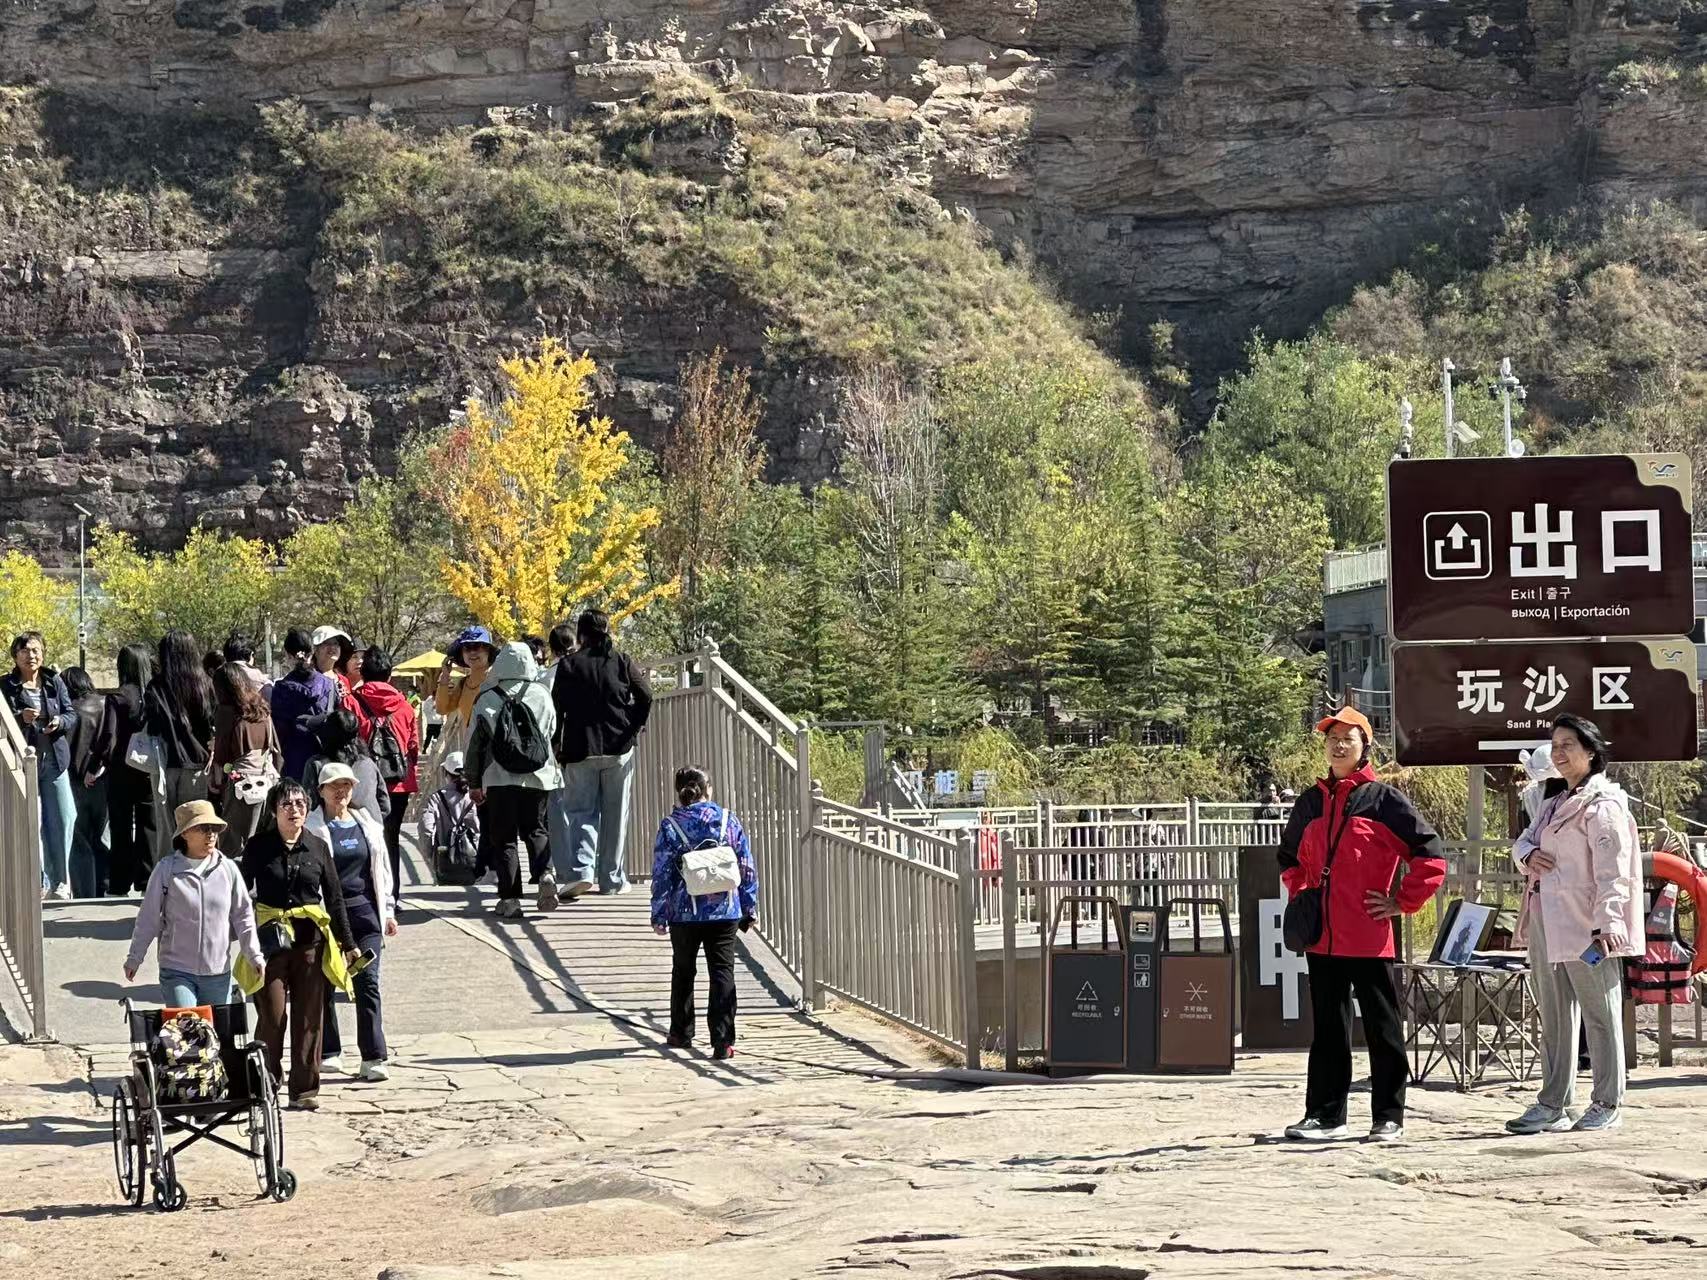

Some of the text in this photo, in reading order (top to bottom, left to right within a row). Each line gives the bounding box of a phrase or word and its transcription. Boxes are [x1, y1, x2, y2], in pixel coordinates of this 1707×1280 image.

[1509, 503, 1662, 580] 出口
[1510, 588, 1536, 600] Exit
[1546, 586, 1572, 600] 출구
[1560, 604, 1631, 621] Exportación
[1456, 665, 1635, 715] 玩沙区
[1506, 719, 1553, 729] Sand Pla
